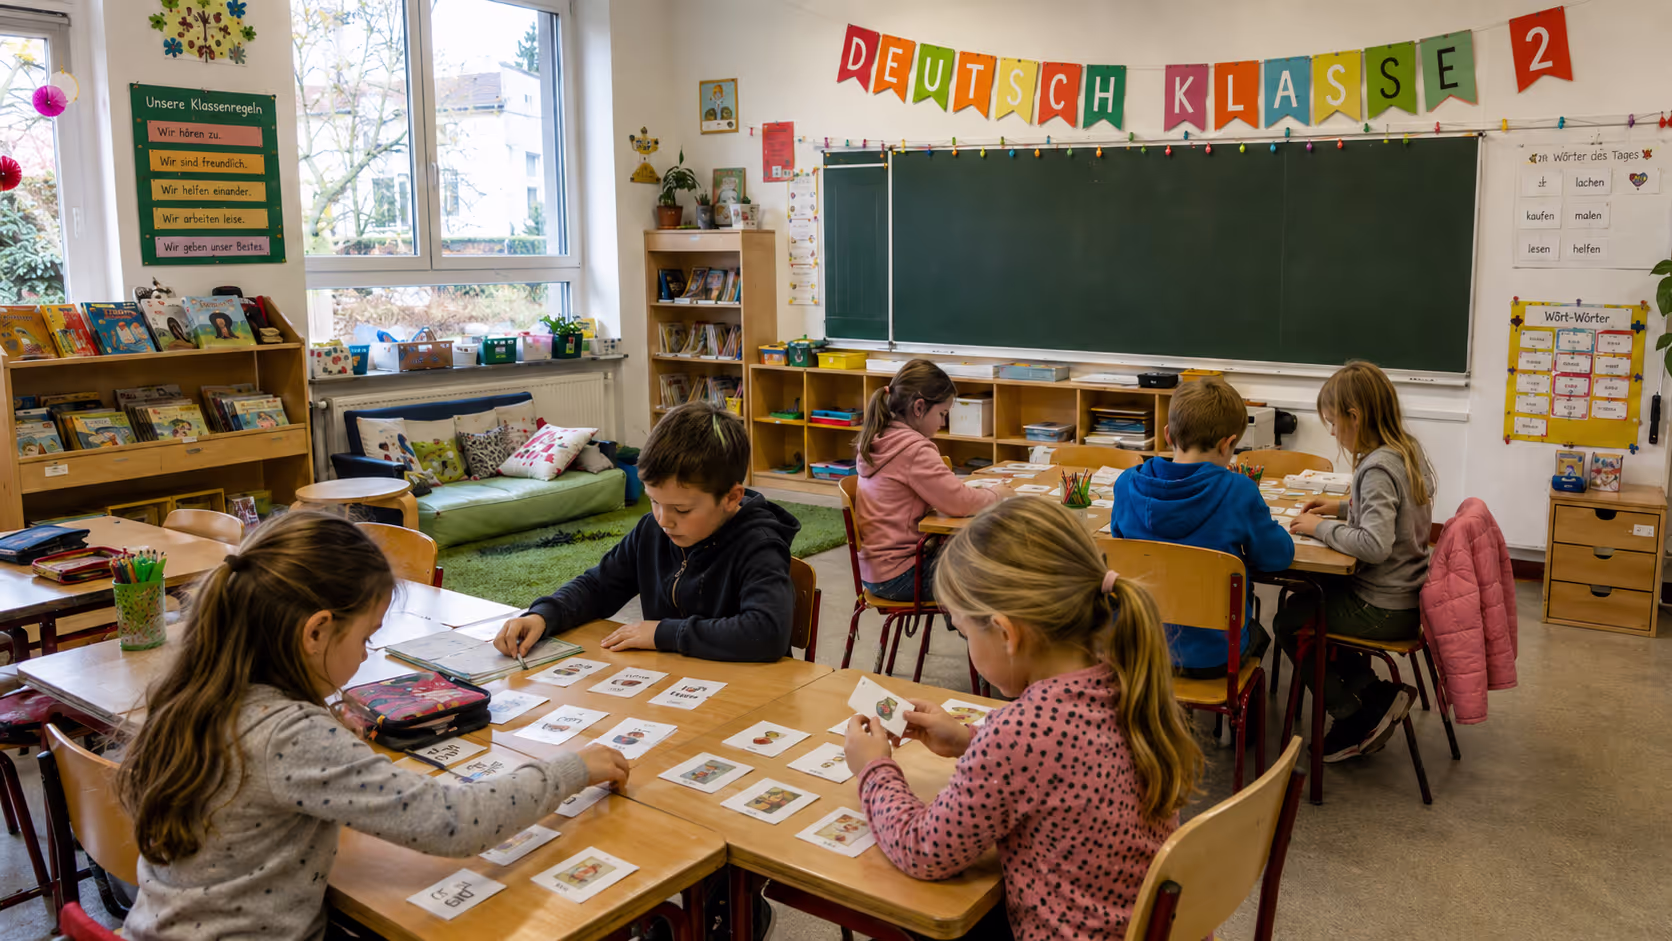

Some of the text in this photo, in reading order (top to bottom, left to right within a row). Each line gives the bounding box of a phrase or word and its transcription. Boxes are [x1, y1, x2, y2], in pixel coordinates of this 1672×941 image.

[847, 26, 1554, 115] DEUTSCH KLASSE 2
[146, 95, 263, 118] Unsere Klassenregeln
[157, 127, 176, 137] Wir
[208, 131, 222, 140] zu.
[159, 156, 248, 169] Wir sind freundlich.
[1591, 149, 1608, 161] des
[1611, 150, 1640, 163] Tages
[1575, 177, 1605, 188] lachen
[161, 184, 252, 197] Wir helfen einander.
[162, 212, 246, 224] Wir arbeiten leise.
[1526, 210, 1555, 222] kaufen
[1574, 211, 1602, 220] malen
[163, 241, 265, 255] Wir geben unser Bestes.
[1528, 244, 1551, 254] lesen
[1573, 244, 1601, 255] helfen
